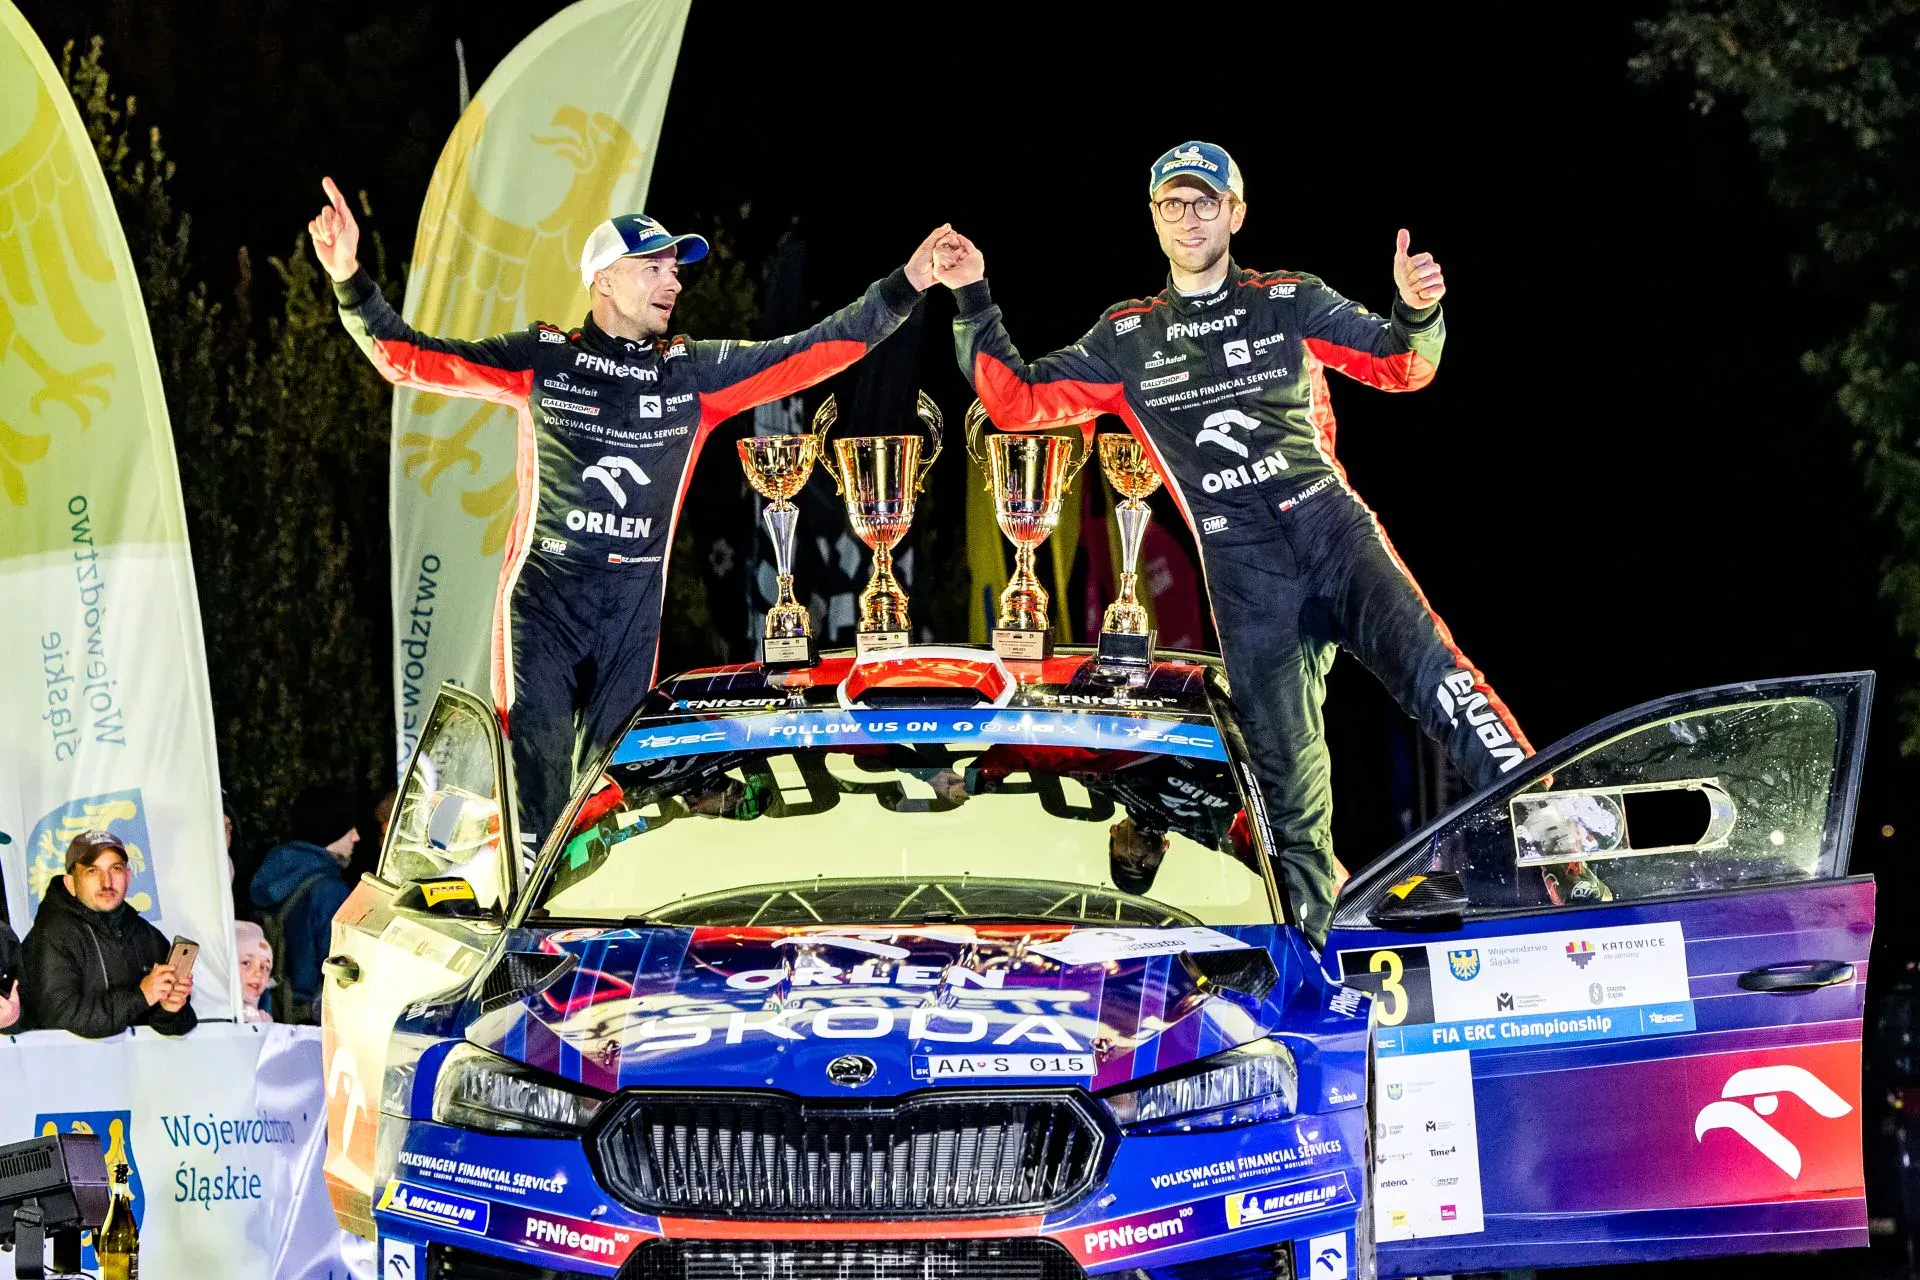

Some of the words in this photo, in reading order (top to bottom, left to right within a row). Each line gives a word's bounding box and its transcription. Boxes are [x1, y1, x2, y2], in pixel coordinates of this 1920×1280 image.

[1269, 285, 1297, 299] OMP
[539, 331, 566, 344] OMP
[1115, 316, 1142, 335] OMP
[1253, 333, 1285, 349] ORLEN
[666, 393, 694, 405] ORLEN
[1145, 390, 1199, 408] VOLKSWAGEN
[1199, 378, 1246, 397] FINANCIAL
[1247, 367, 1288, 386] SERVICES
[667, 405, 677, 413] OIL
[543, 416, 604, 434] VOLKSWAGEN
[605, 428, 653, 441] FINANCIAL
[654, 426, 689, 438] SERVICES
[1202, 450, 1290, 493] ORLEN
[1298, 474, 1336, 502] MARCZYK
[566, 509, 652, 539] ORLEN
[1203, 516, 1229, 534] OMP
[540, 538, 566, 554] OMP
[768, 722, 861, 739] FOLLOW
[868, 721, 898, 735] US
[906, 720, 938, 733] ON
[1602, 937, 1665, 951] KATOWICE
[726, 965, 1006, 991] ORLEN
[1369, 950, 1409, 1026] 3
[1433, 1026, 1460, 1044] FIA
[1464, 1022, 1496, 1040] ERC
[1502, 1015, 1612, 1038] Championship
[915, 1067, 928, 1076] SK
[938, 1057, 973, 1075] AA
[994, 1056, 1009, 1073] S
[1030, 1056, 1084, 1073] 015
[398, 1151, 457, 1174] VOLKSWAGEN
[457, 1162, 511, 1185] FINANCIAL
[513, 1173, 568, 1194] SERVICES
[1151, 1160, 1236, 1190] VOLKSWAGEN
[1237, 1149, 1296, 1171] FINANCIAL
[1298, 1139, 1342, 1159] SERVICES
[174, 1161, 262, 1210] Śląskie
[1264, 1185, 1337, 1211] MICHELIN
[408, 1196, 476, 1221] MICHELIN
